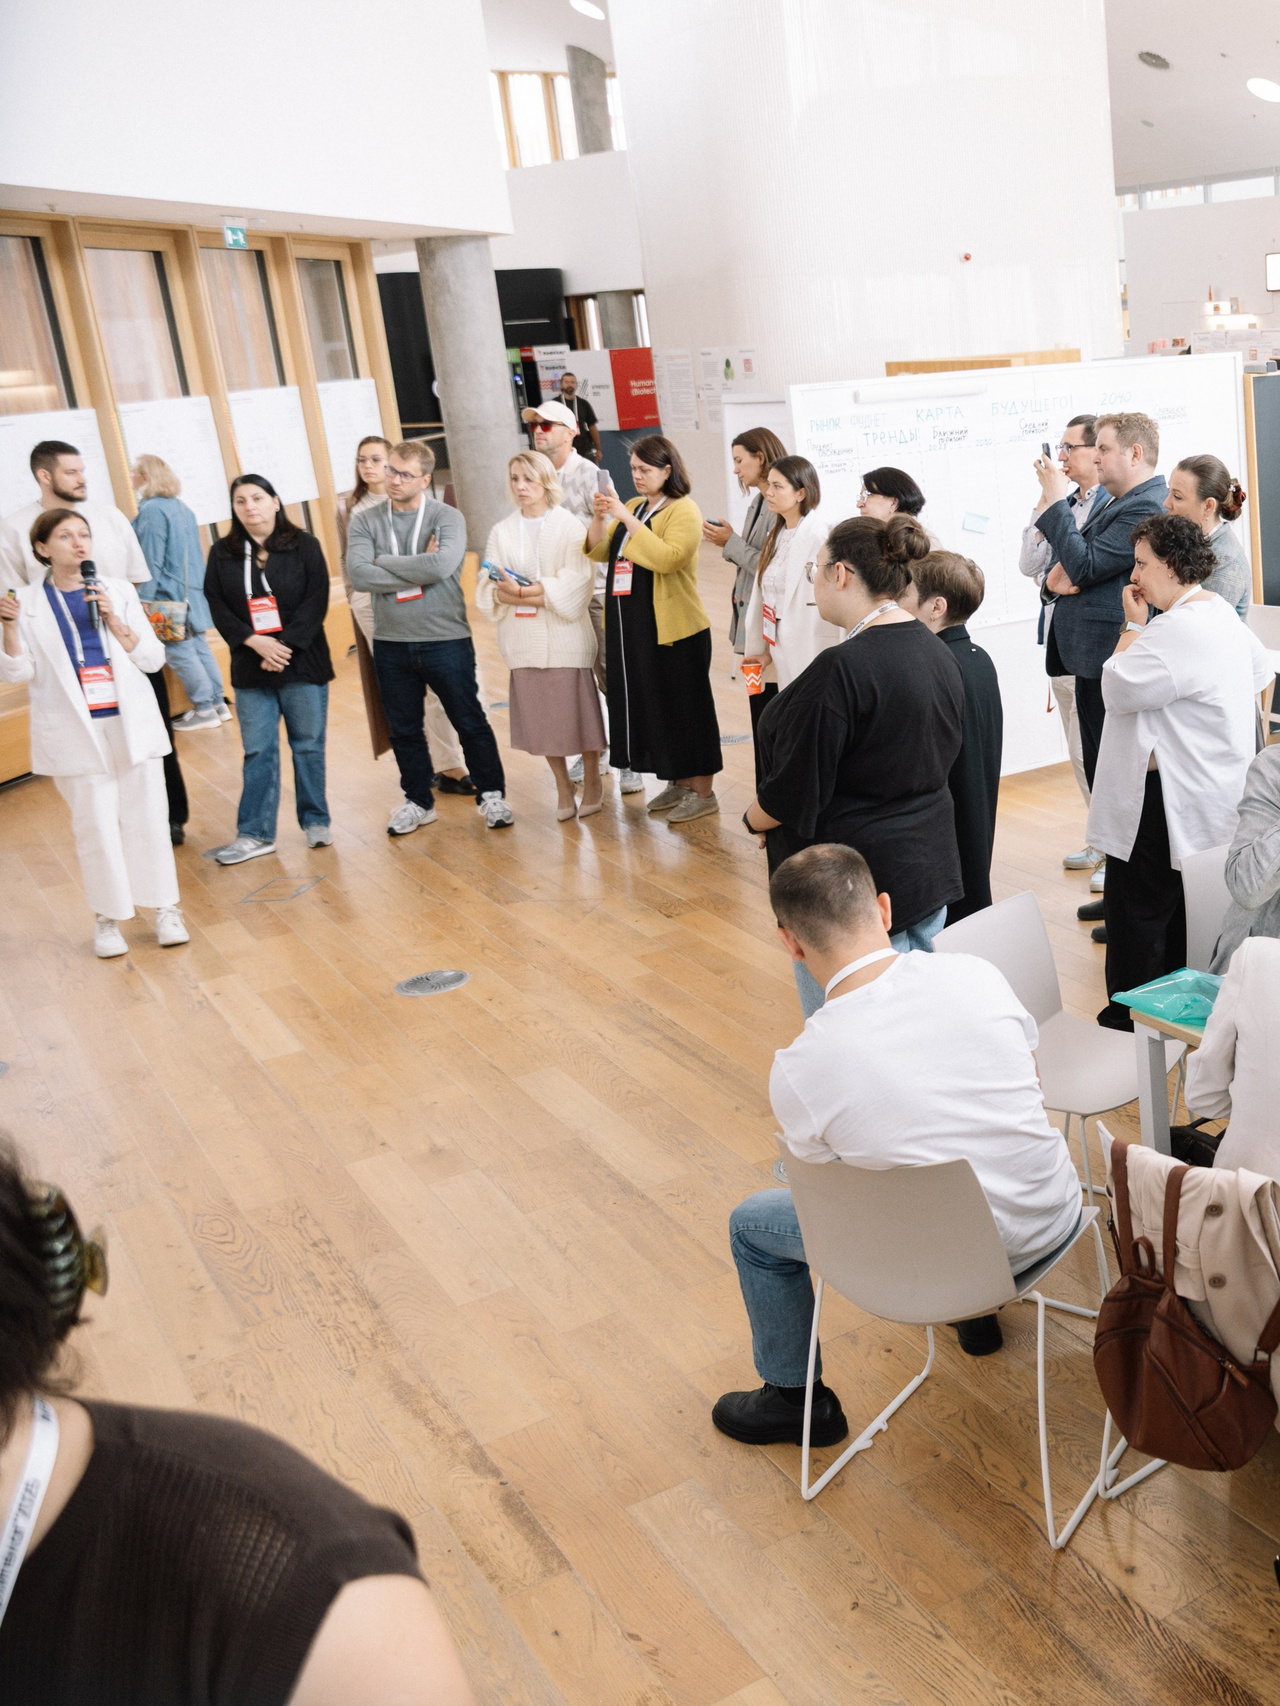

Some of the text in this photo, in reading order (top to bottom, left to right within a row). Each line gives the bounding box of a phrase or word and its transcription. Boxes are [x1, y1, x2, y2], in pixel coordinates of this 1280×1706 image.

[915, 391, 1132, 423] КАРТА БУДУЩЕГО 2040
[809, 413, 887, 433] РЫНОК ФУДНЕТ
[863, 428, 919, 447] ТРЕНДЫ
